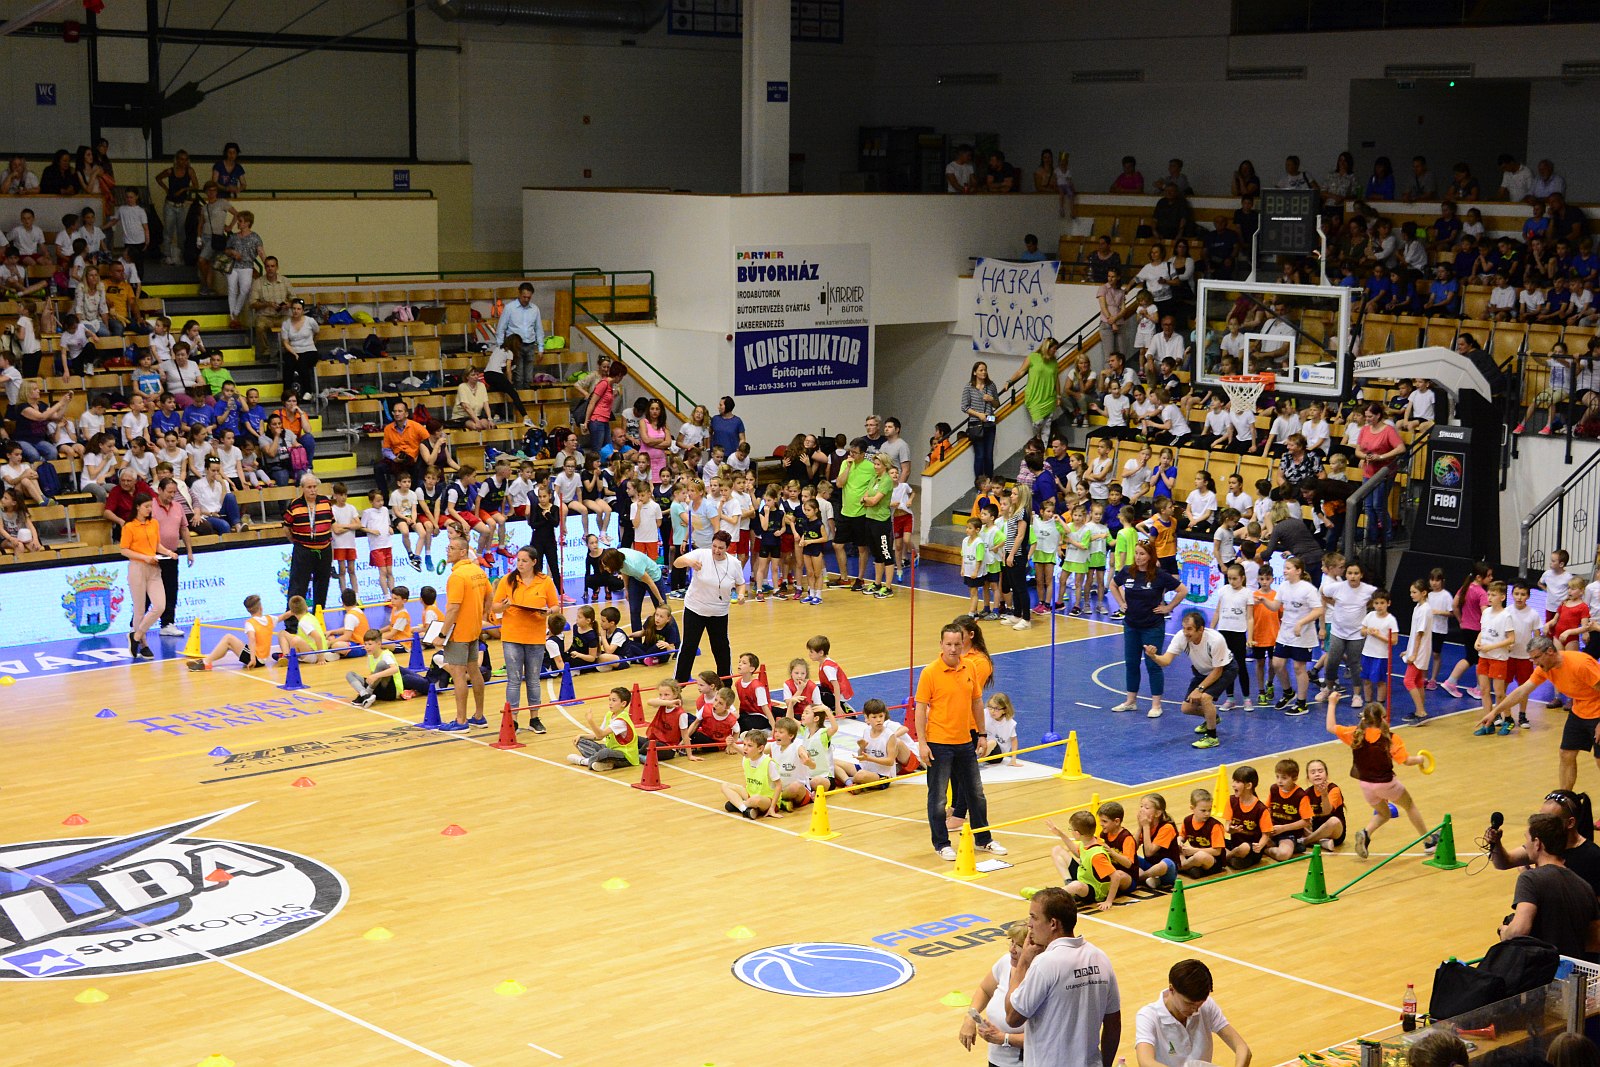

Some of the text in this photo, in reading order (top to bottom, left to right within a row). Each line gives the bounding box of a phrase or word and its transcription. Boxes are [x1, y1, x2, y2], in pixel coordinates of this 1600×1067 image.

[39, 84, 54, 96] WC
[736, 250, 784, 260] PARTNER
[737, 260, 820, 282] BÚTORHÁZ
[981, 263, 1044, 295] HAJRÁ
[736, 288, 781, 299] IRODABÚTOROK
[841, 304, 864, 313] BÚTOR
[736, 318, 785, 330] LAKBERENDEZÉS
[974, 308, 1054, 343] TÓVÁROS
[743, 333, 861, 372] KONSTRUKTOR
[817, 364, 834, 376] Kft.
[1433, 493, 1457, 509] FIBA
[128, 692, 347, 732] FEHÉRVÁR
[144, 707, 324, 736] TRAVEL
[0, 844, 284, 947] LBA
[75, 903, 305, 957] sportopus
[871, 913, 992, 947] FIBA
